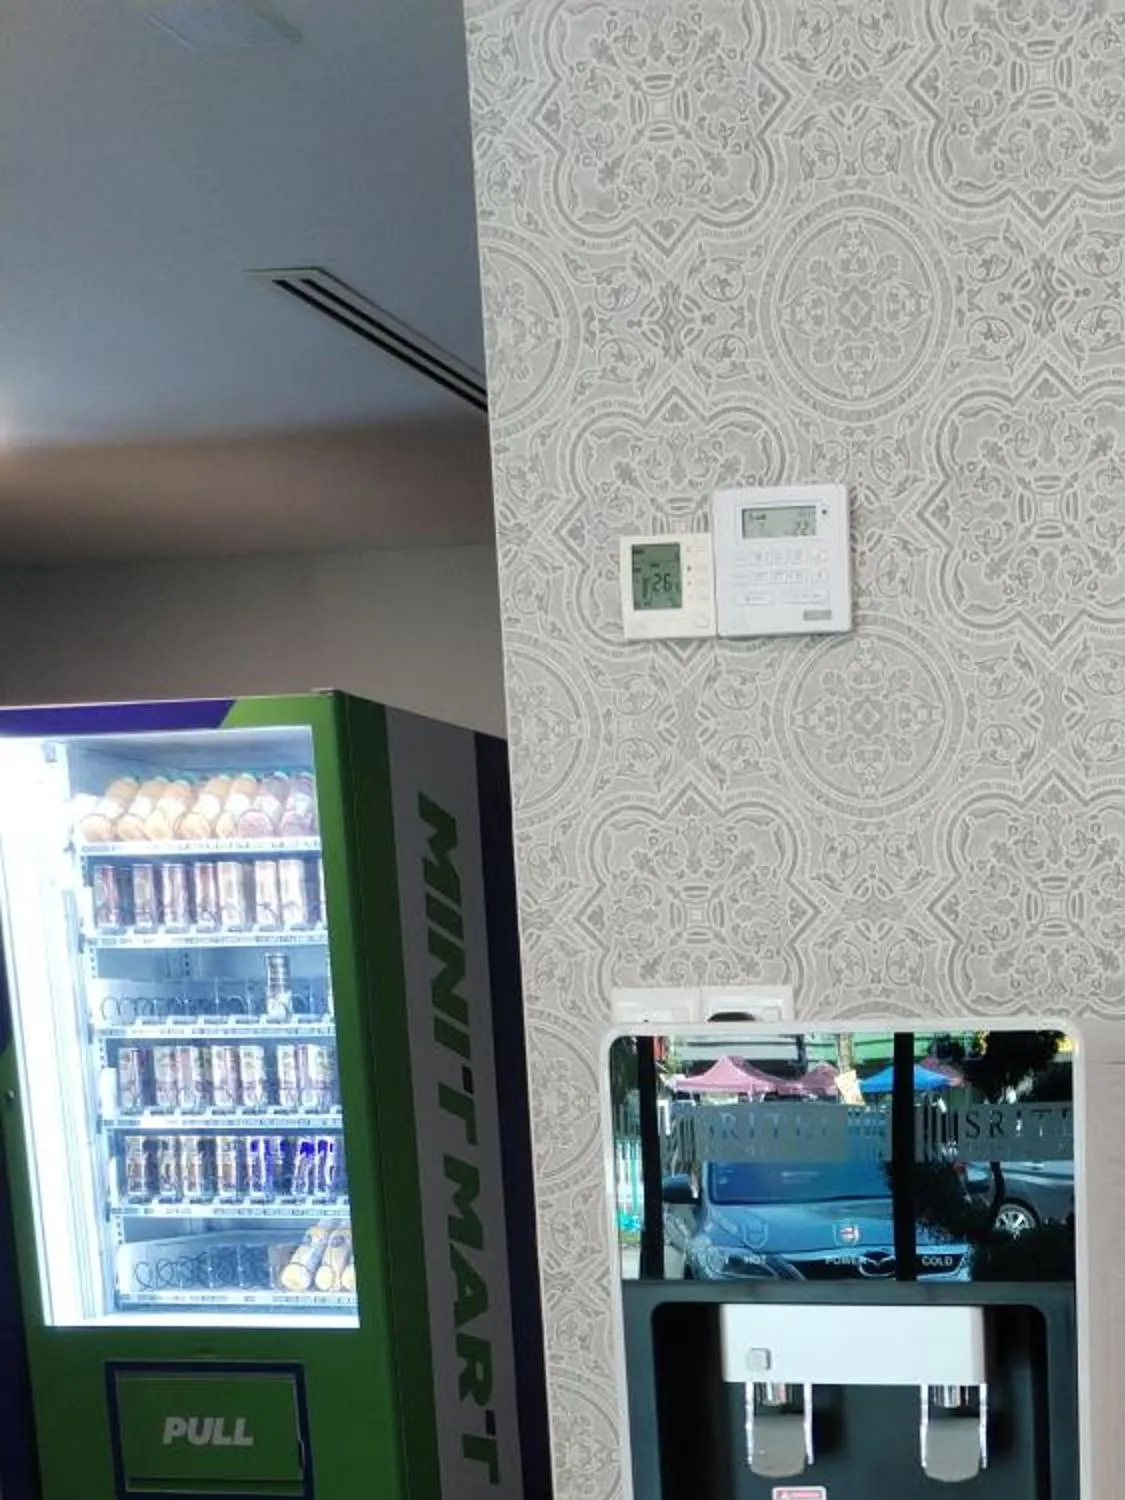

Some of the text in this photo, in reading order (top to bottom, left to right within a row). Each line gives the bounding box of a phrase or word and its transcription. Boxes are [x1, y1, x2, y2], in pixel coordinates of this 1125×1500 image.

[418, 792, 500, 1486] MINIT MART
[921, 1255, 953, 1267] COLD
[162, 1416, 254, 1446] PULL
